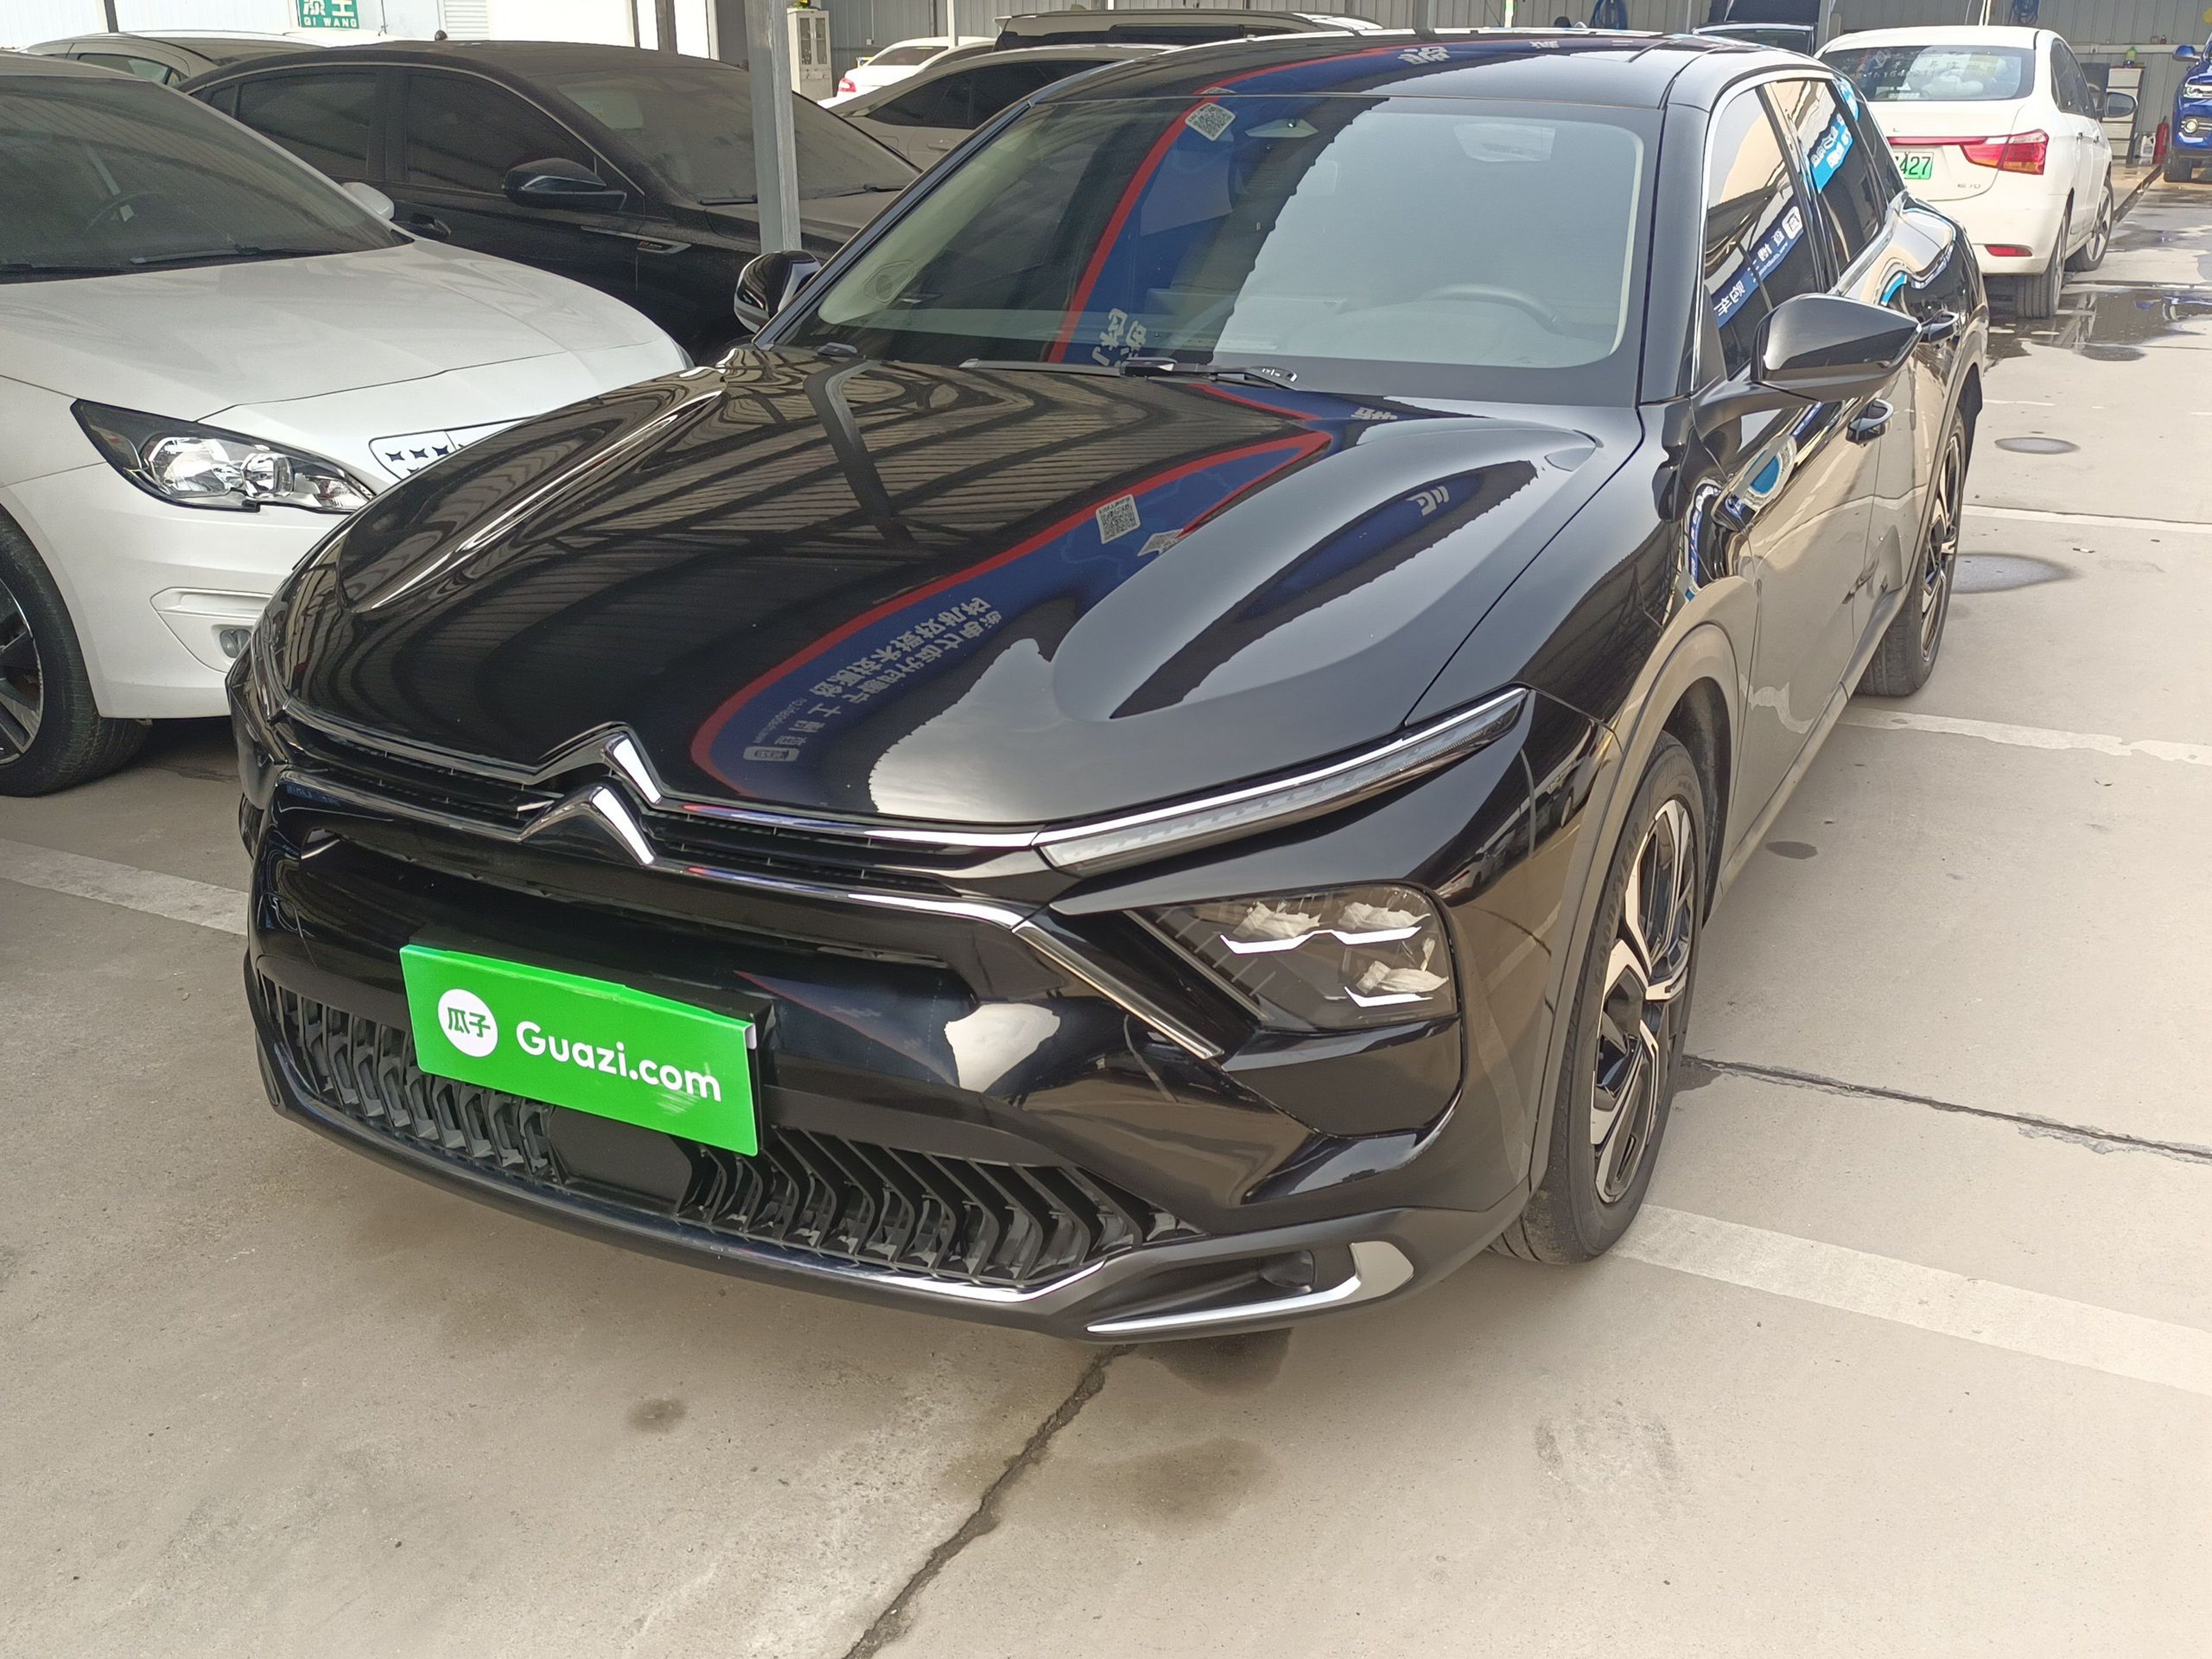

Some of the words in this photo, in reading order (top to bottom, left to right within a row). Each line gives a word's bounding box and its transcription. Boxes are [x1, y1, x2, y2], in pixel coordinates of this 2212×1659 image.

[304, 17, 316, 26] QI
[323, 17, 357, 27] WANG
[1895, 155, 1931, 176] 427
[448, 1006, 491, 1038] 瓜子
[516, 1021, 722, 1102] Guazi.com
